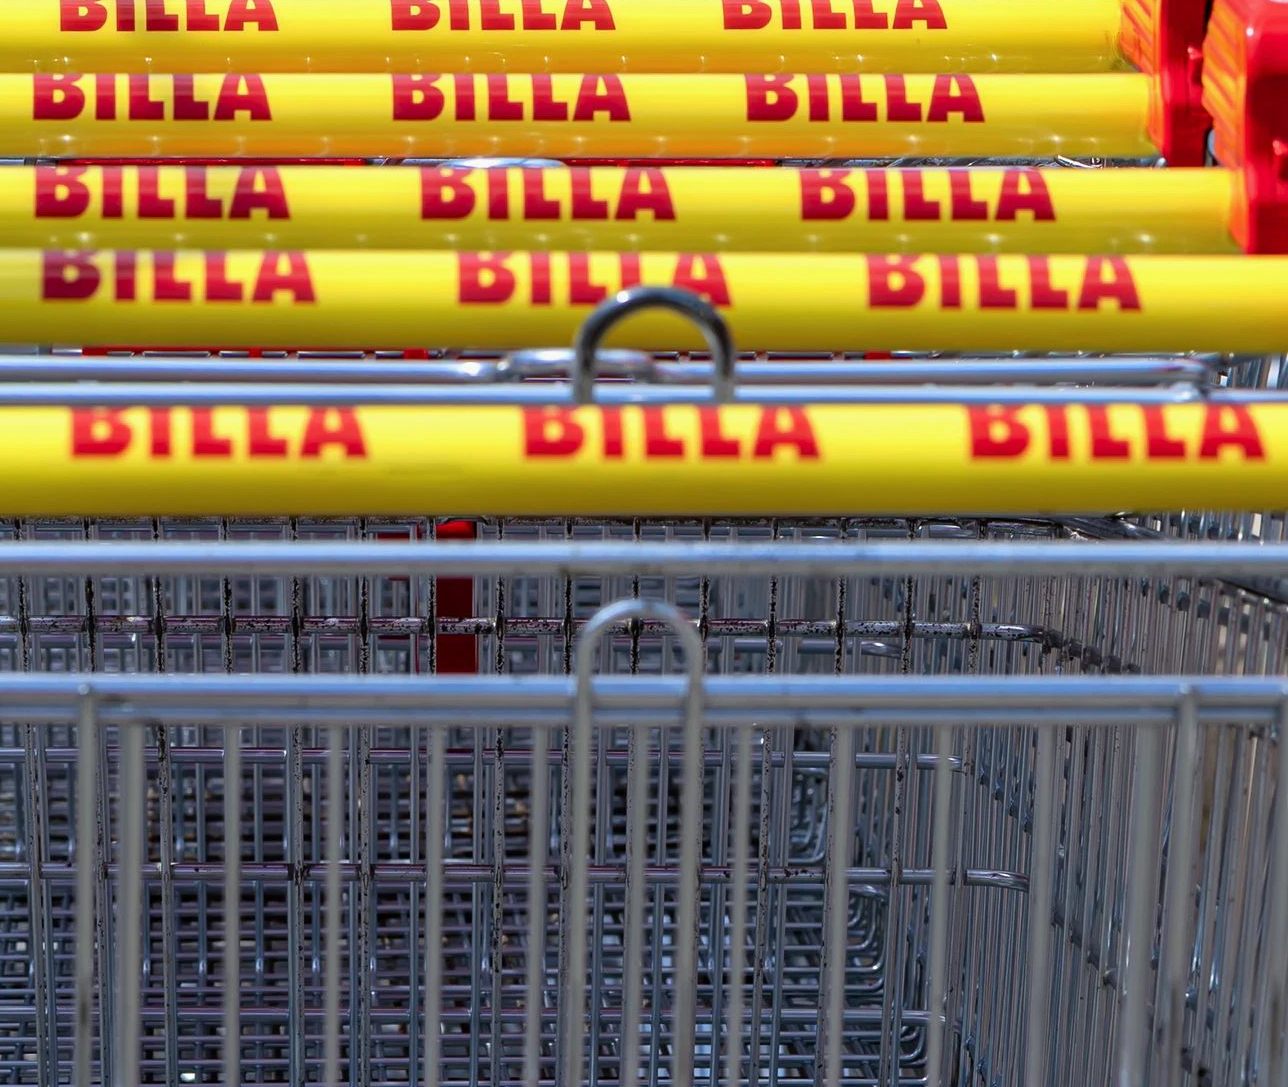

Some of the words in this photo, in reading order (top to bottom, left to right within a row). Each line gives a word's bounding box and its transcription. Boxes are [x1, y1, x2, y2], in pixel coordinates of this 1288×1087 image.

[32, 73, 273, 121] BILLA
[392, 73, 632, 122] BILLA
[745, 73, 985, 123] BILLA
[34, 165, 291, 219] BILLA
[419, 166, 676, 221] BILLA
[799, 168, 1057, 222] BILLA
[41, 250, 317, 302] BILLA
[867, 255, 1142, 311] BILLA
[70, 406, 369, 459] BILLA
[523, 406, 821, 461] BILLA
[966, 404, 1266, 462] BILLA
